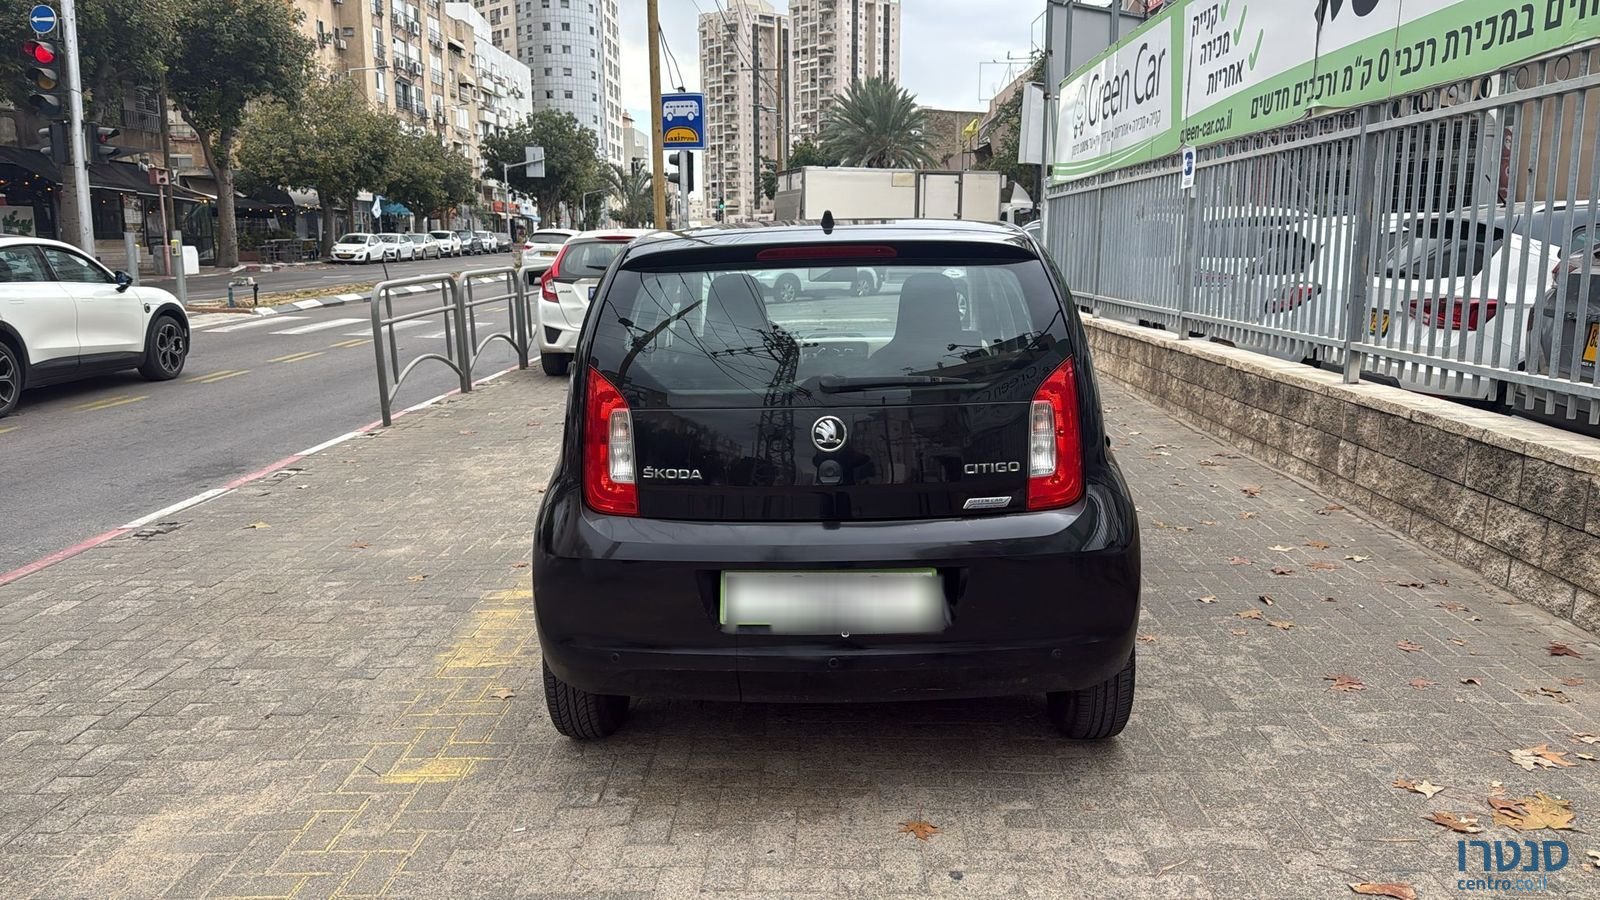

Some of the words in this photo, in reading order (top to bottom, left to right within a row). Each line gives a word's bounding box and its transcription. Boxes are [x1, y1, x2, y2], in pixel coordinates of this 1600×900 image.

[1192, 3, 1219, 38] קנייה
[1441, 3, 1535, 63] במכירת
[1200, 31, 1230, 66] מכירה
[1378, 48, 1390, 83] 0
[1395, 37, 1437, 77] רכבי
[1088, 69, 1130, 127] Green
[1134, 42, 1166, 105] Car
[1206, 59, 1245, 96] אחריות
[1250, 86, 1290, 119] חדשים
[642, 464, 703, 480] ŠKODA
[964, 461, 1020, 474] CITIGO
